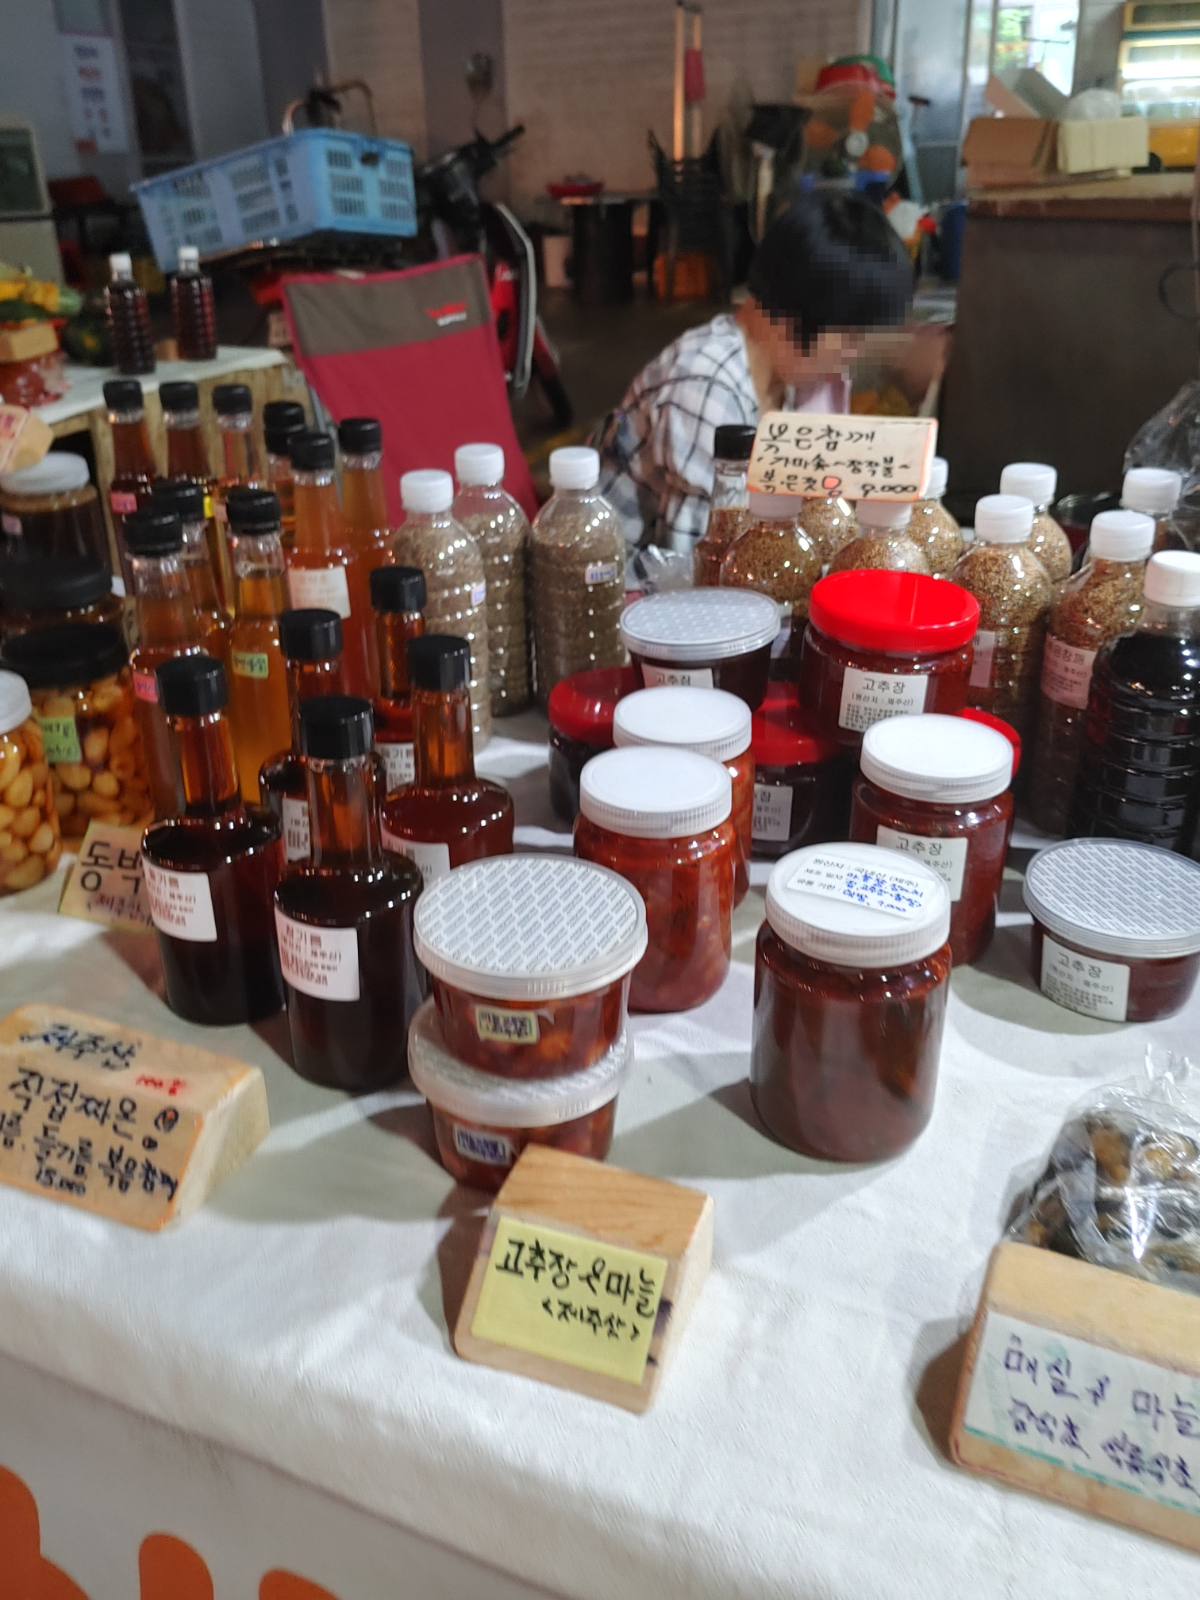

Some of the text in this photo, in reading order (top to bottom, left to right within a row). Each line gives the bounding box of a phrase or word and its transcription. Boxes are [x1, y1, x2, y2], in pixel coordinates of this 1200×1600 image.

[861, 677, 906, 695] 고추장
[895, 836, 944, 857] 고추장
[1056, 951, 1103, 979] 고추장
